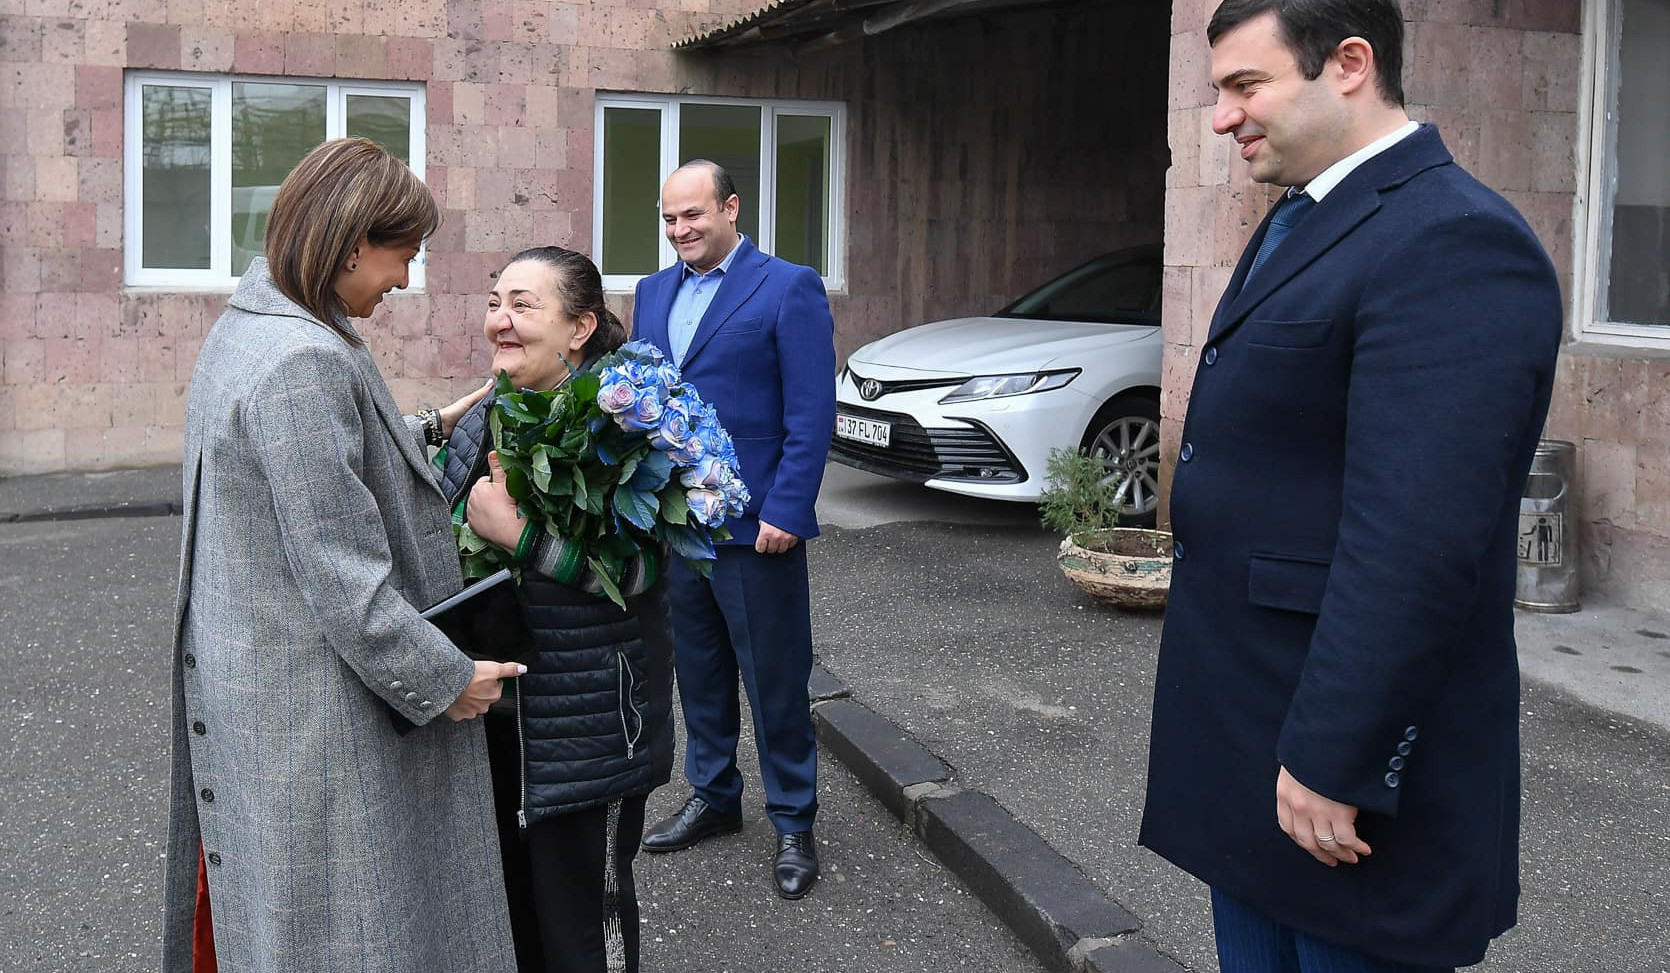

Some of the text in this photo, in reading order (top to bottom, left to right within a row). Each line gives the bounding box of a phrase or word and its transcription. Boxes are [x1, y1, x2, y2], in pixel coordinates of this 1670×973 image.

[847, 419, 887, 442] 37 FL 704
